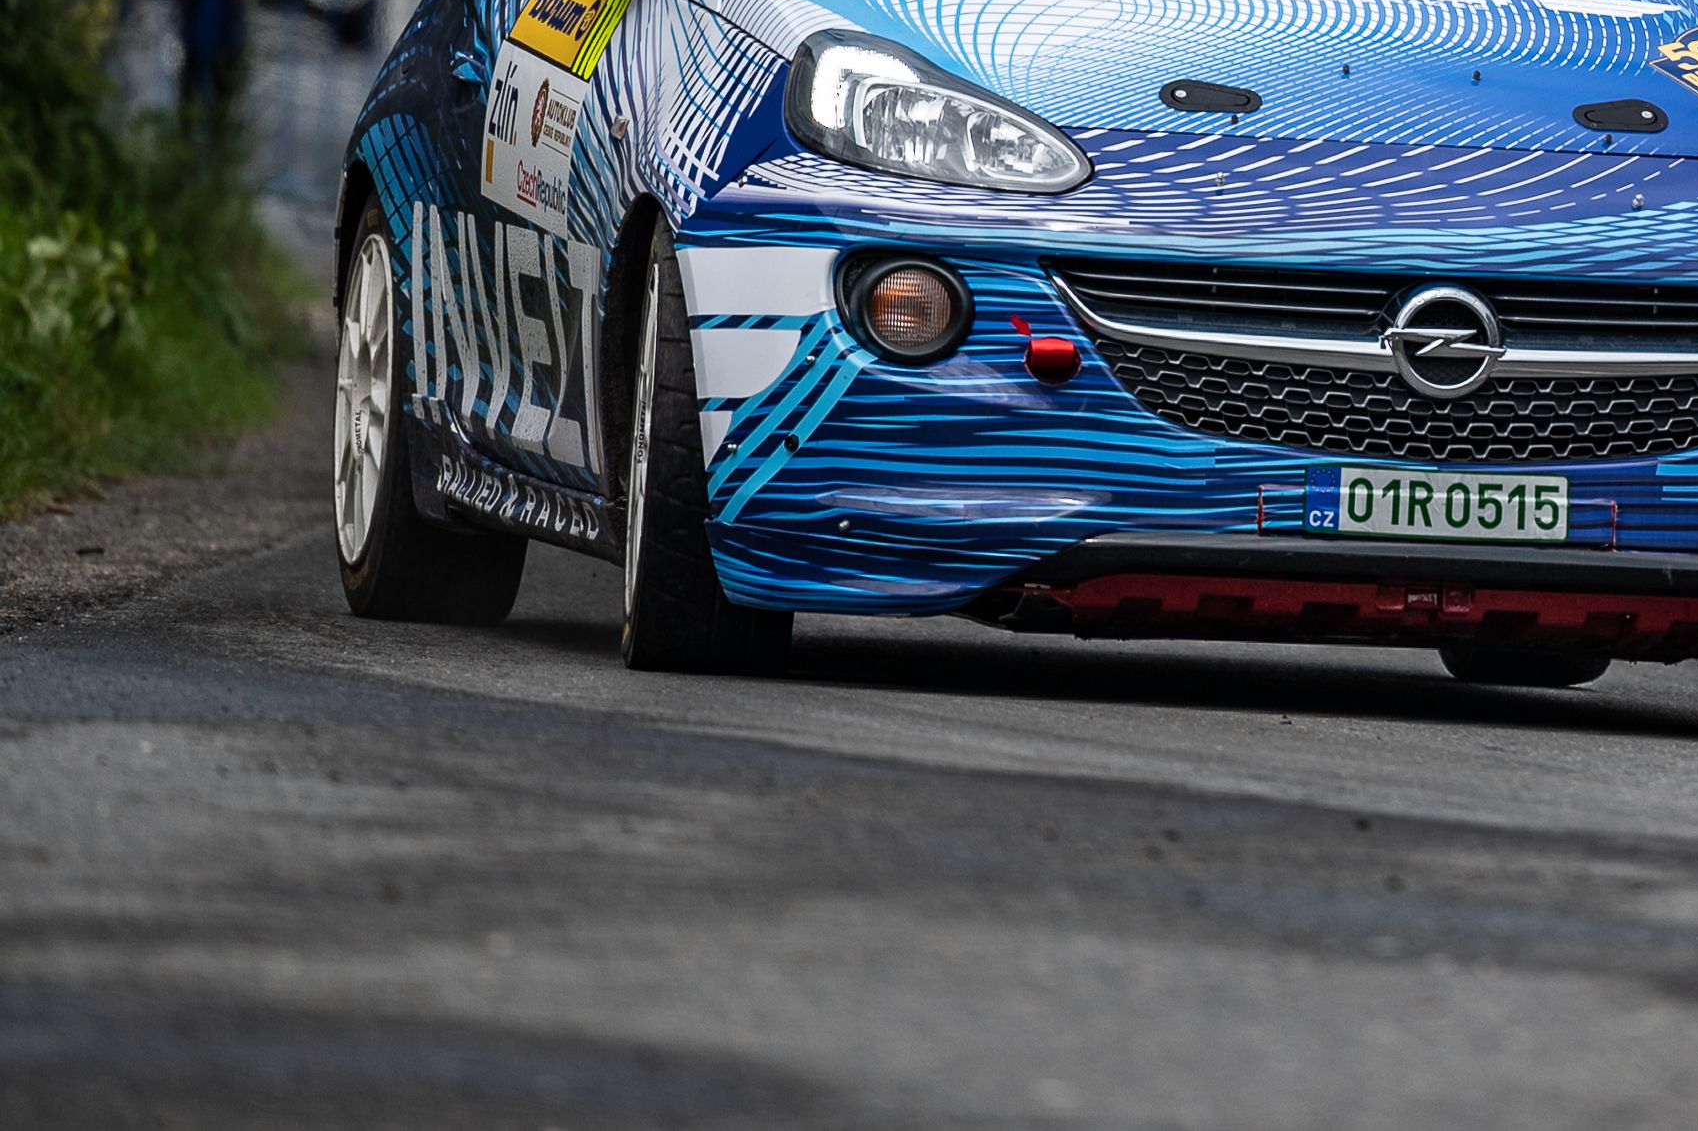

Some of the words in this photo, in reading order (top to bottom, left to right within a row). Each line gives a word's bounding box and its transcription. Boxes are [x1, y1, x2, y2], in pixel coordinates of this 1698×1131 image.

[547, 98, 577, 130] AUTOKLUB
[519, 485, 599, 540] RACED
[1309, 510, 1335, 528] CZ
[1347, 477, 1434, 528] 01R
[1445, 482, 1561, 531] 0515
